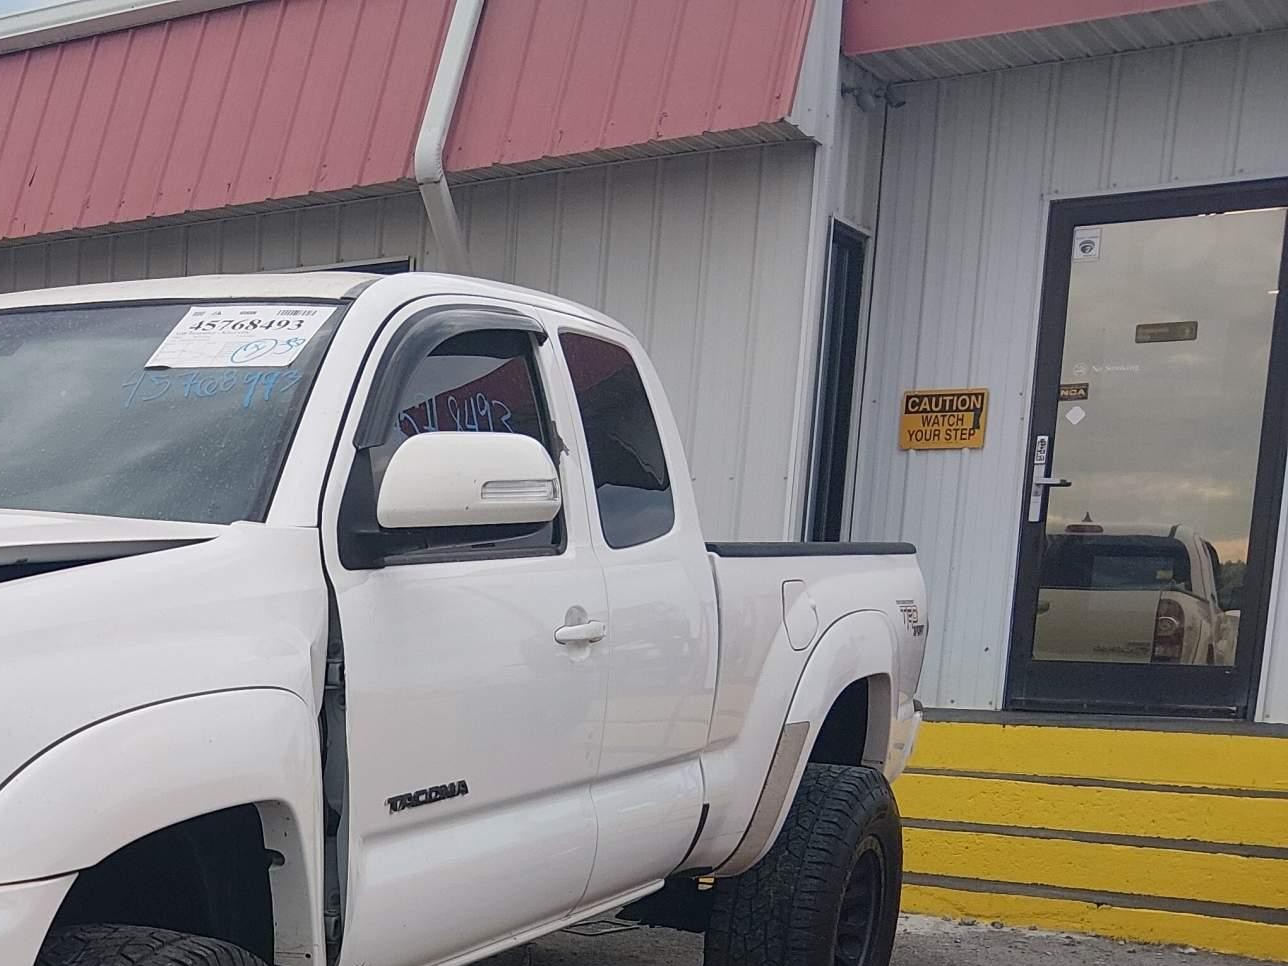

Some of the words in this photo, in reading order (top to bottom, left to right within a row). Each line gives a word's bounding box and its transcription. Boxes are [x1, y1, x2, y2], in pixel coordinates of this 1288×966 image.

[188, 318, 306, 332] 45768493
[907, 395, 982, 412] CAUTION
[921, 414, 965, 427] WATCH
[907, 429, 941, 442] YOUR
[944, 427, 976, 441] STEP
[898, 604, 919, 628] TRD
[385, 778, 469, 813] TACOMA
